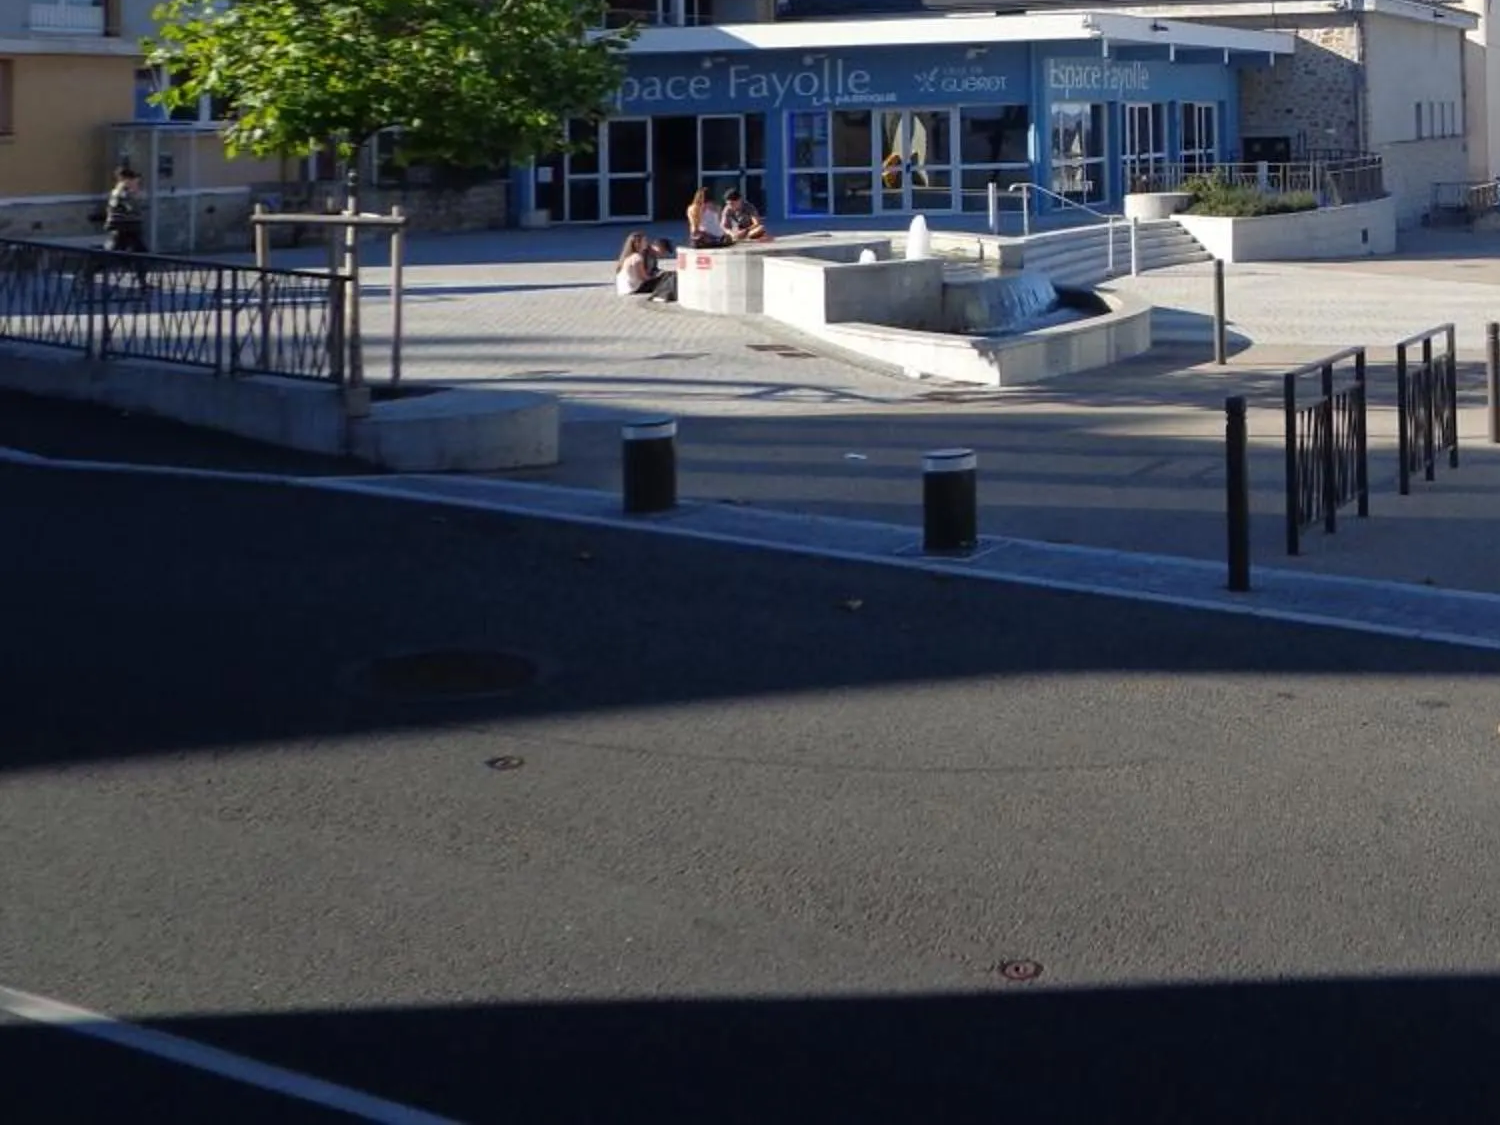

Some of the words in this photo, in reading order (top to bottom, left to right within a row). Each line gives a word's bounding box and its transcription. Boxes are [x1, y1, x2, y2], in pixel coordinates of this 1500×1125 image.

[602, 74, 712, 111] pace
[728, 58, 871, 108] Fayolle
[1049, 58, 1101, 100] Espace
[1103, 59, 1150, 99] Fayolle
